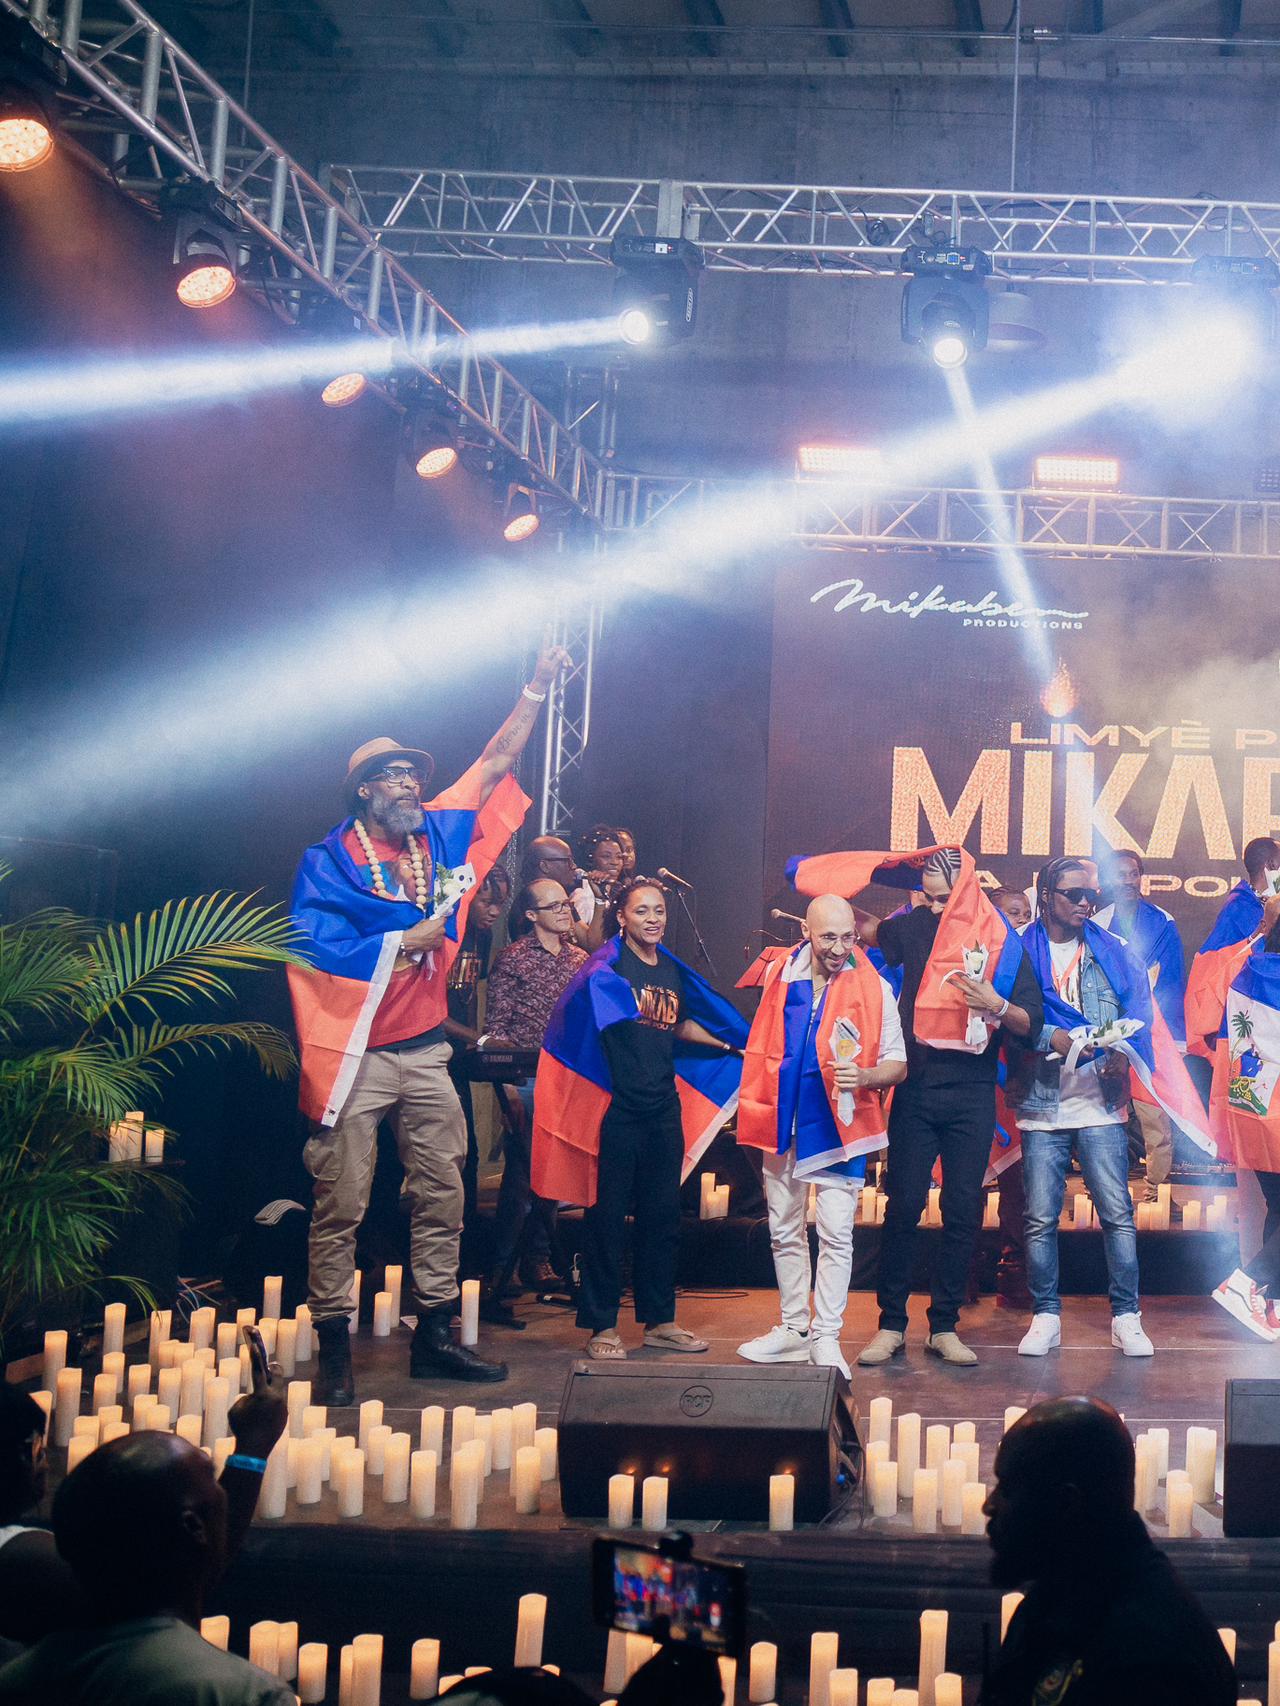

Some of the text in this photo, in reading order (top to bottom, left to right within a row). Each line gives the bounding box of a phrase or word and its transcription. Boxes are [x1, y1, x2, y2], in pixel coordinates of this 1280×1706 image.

[963, 618, 1083, 630] PRODUCIONS
[1010, 719, 1211, 749] LIMYÈ
[1140, 874, 1244, 898] PO
